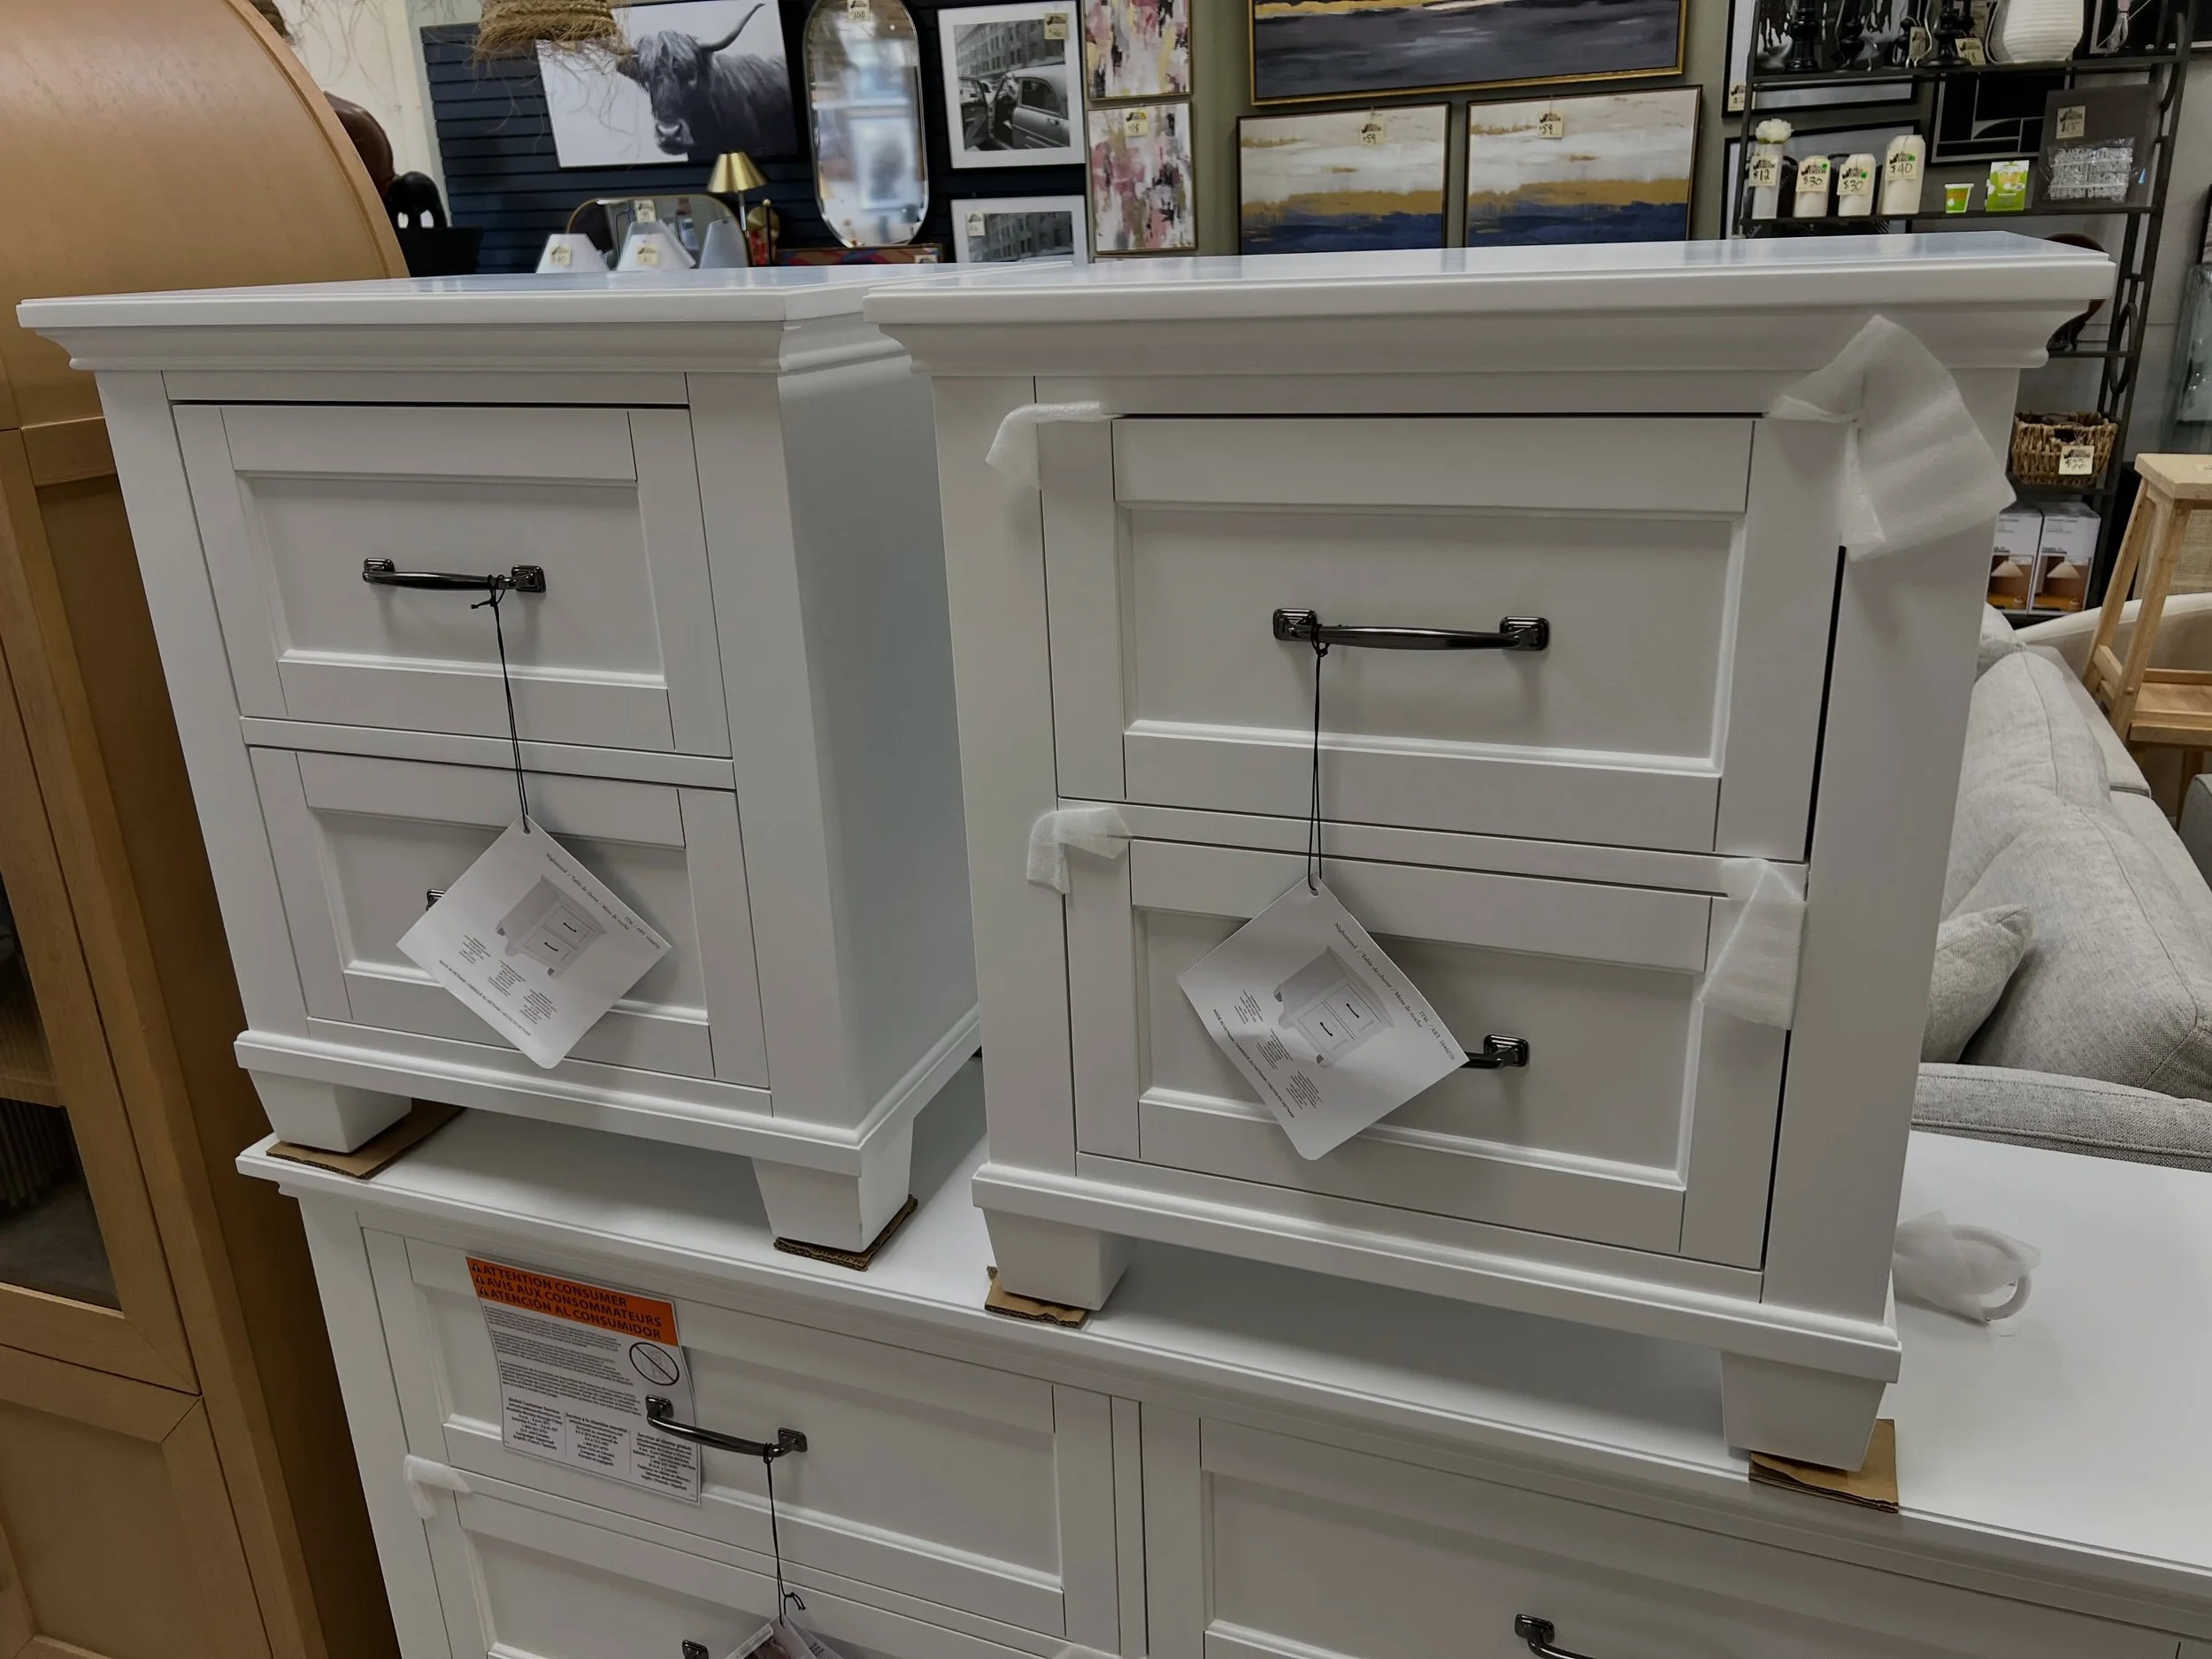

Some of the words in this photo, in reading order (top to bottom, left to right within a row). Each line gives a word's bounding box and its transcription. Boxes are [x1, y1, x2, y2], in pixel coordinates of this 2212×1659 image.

[1890, 163, 1912, 174] $40
[1753, 169, 1770, 180] $12
[1802, 175, 1823, 186] $30
[1843, 180, 1863, 191] $30
[483, 1265, 552, 1289] ATTENTION
[555, 1282, 627, 1308] CONSUMER
[487, 1277, 513, 1292] AVIS
[517, 1284, 542, 1298] AUX
[545, 1290, 662, 1327] CONSOMMATEURS
[491, 1290, 552, 1313] ATENCIÓN
[555, 1305, 572, 1317] AL
[572, 1310, 661, 1340] CONSUMIDOR
